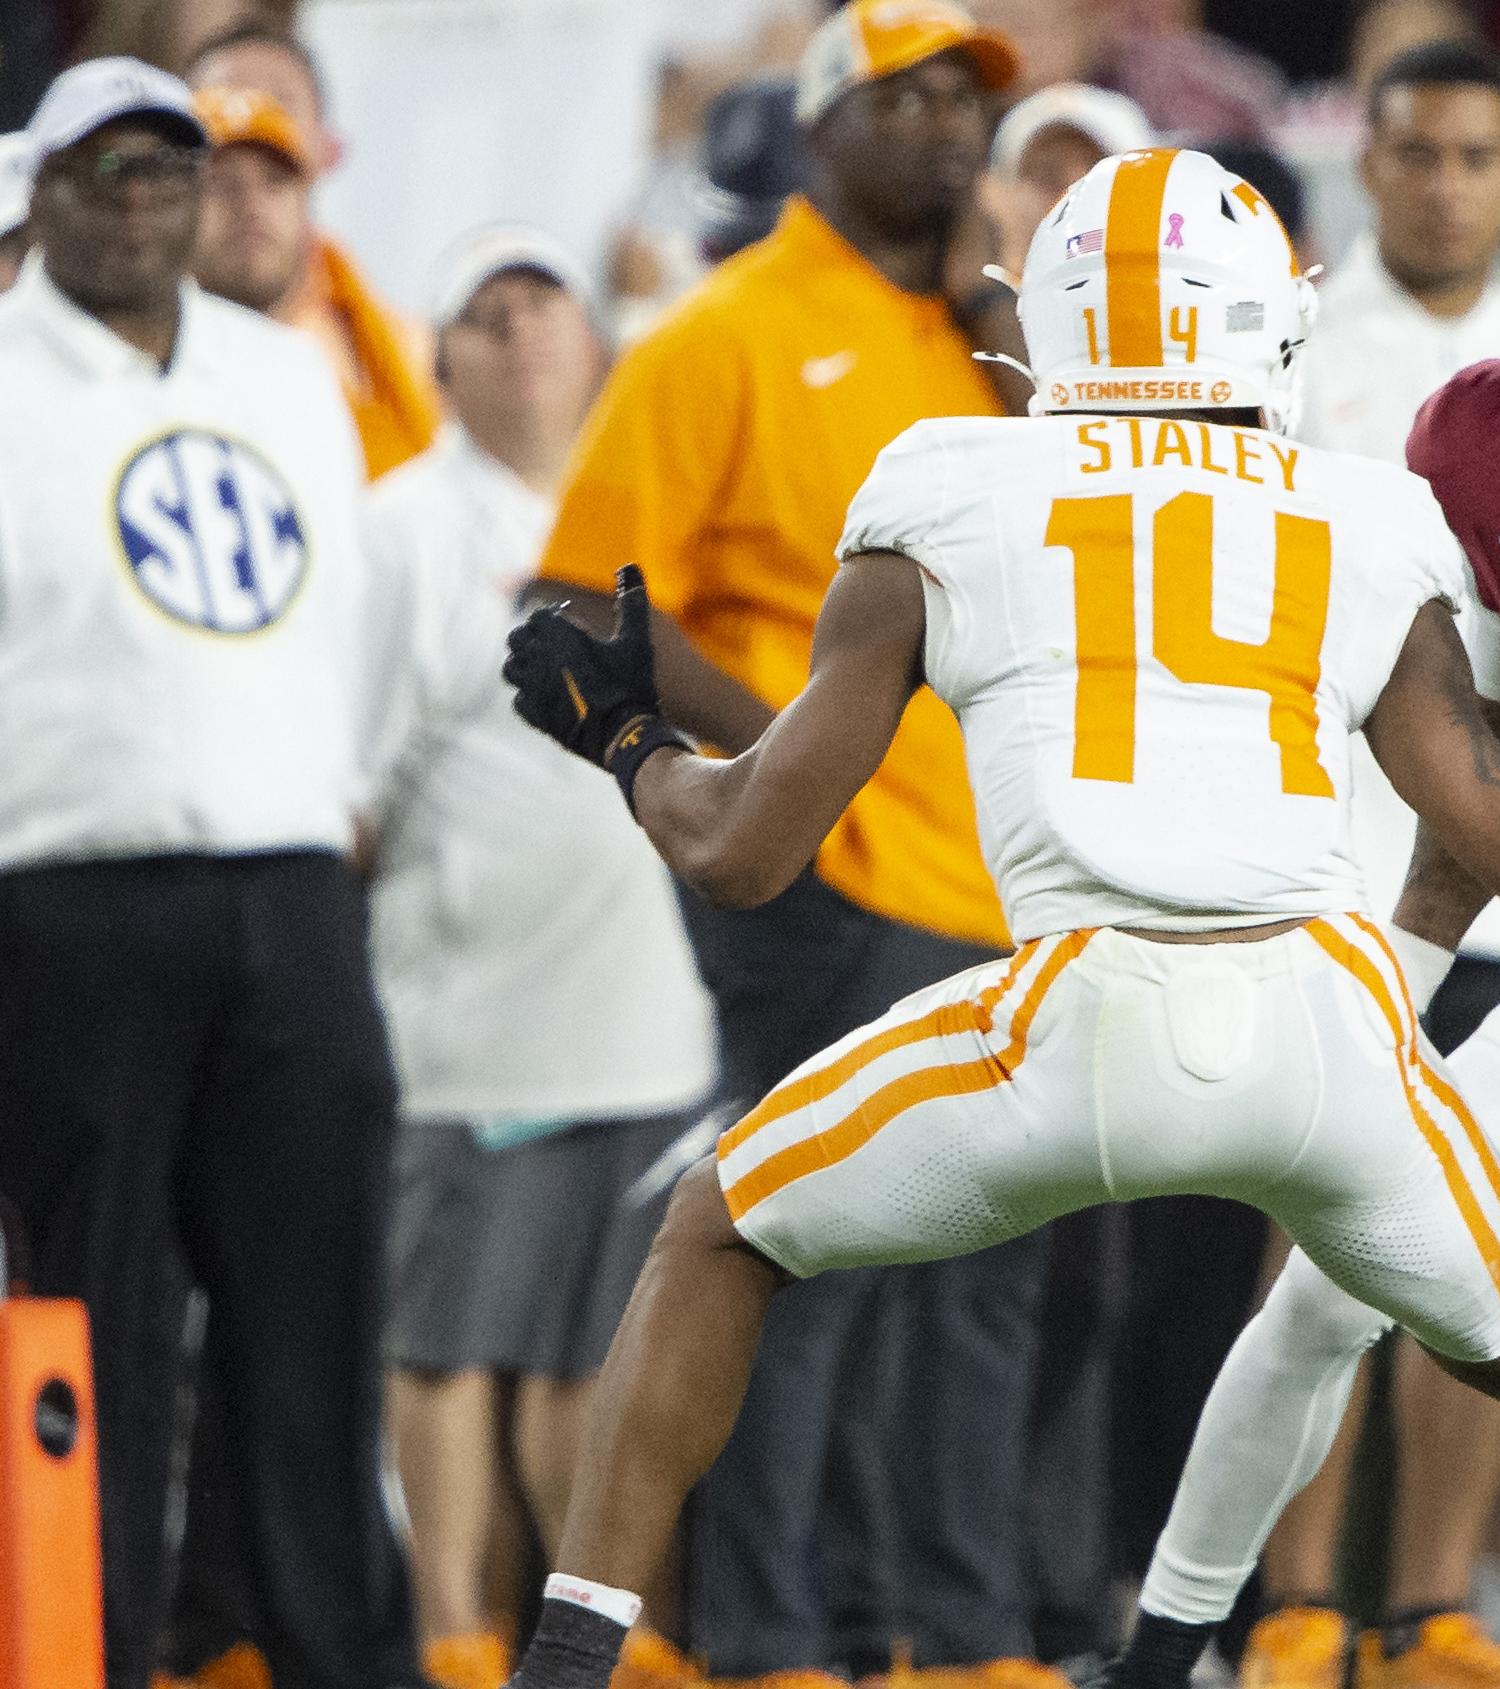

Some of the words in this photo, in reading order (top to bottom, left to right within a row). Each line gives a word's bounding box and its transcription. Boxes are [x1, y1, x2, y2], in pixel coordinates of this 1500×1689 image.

[1074, 381, 1204, 400] TENNESSEE
[1077, 417, 1299, 492] STALEY
[114, 431, 307, 634] SEC
[1043, 490, 1336, 801] 14
